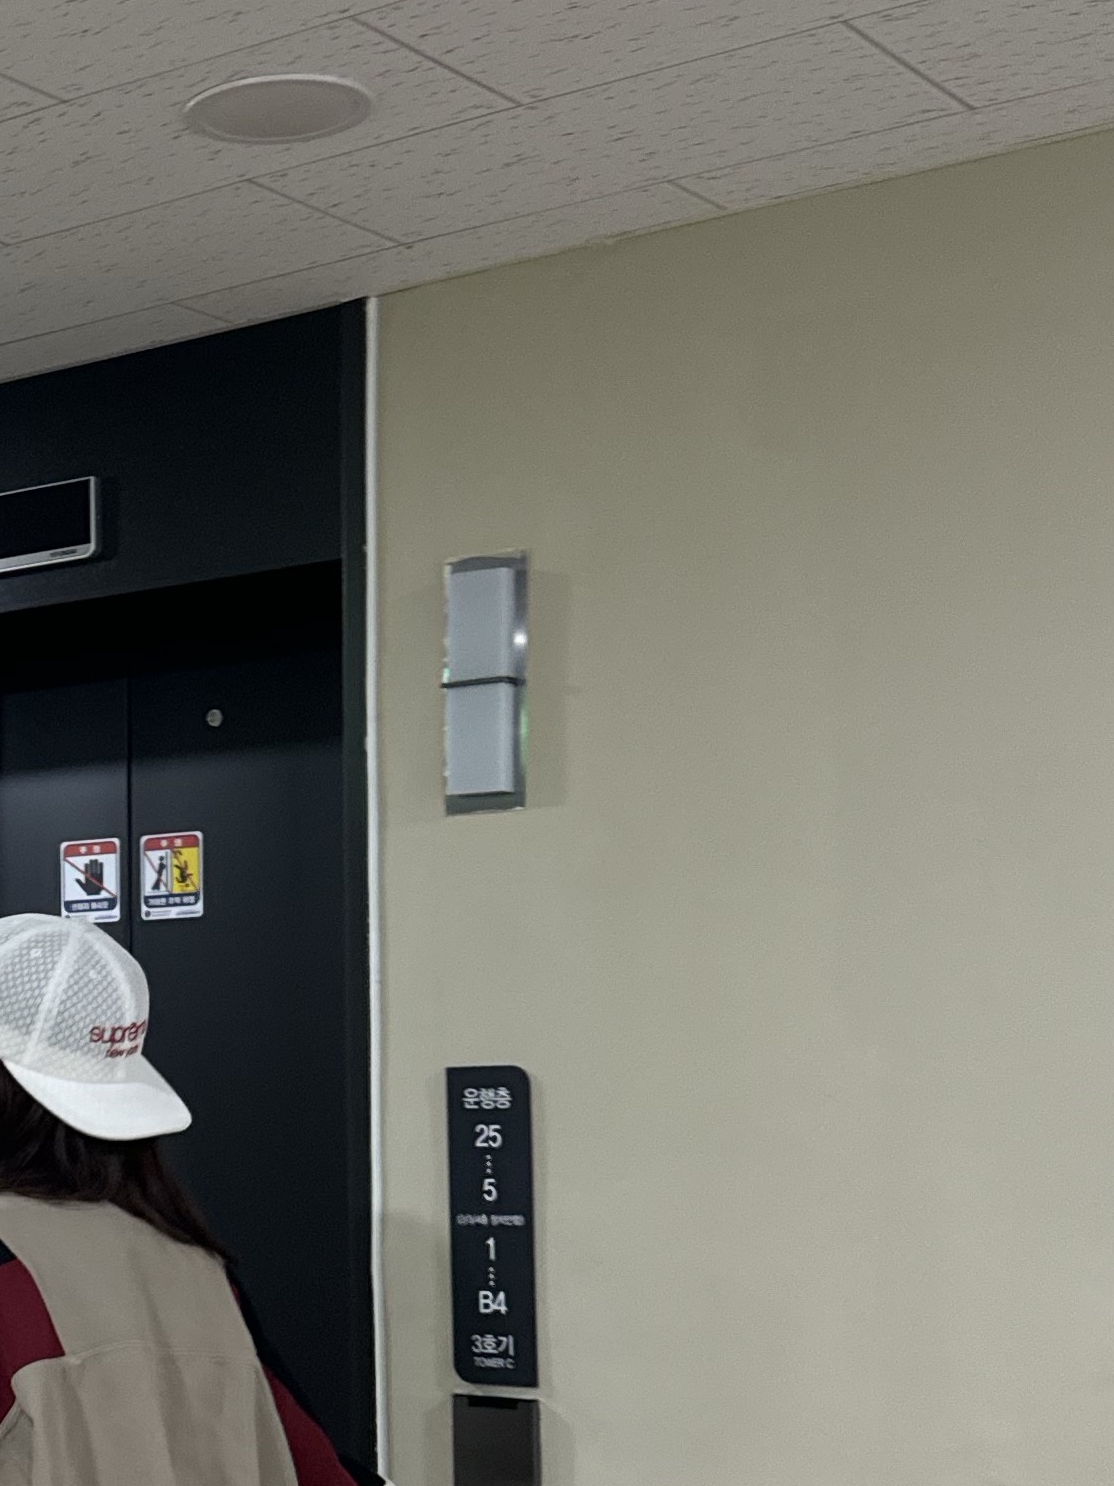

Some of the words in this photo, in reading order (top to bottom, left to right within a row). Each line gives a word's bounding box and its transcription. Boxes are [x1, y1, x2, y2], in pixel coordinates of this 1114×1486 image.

[474, 1124, 502, 1148] 25
[482, 1178, 498, 1202] 5
[485, 1237, 496, 1261] 1
[478, 1290, 508, 1315] B4
[471, 1334, 514, 1356] 3호기
